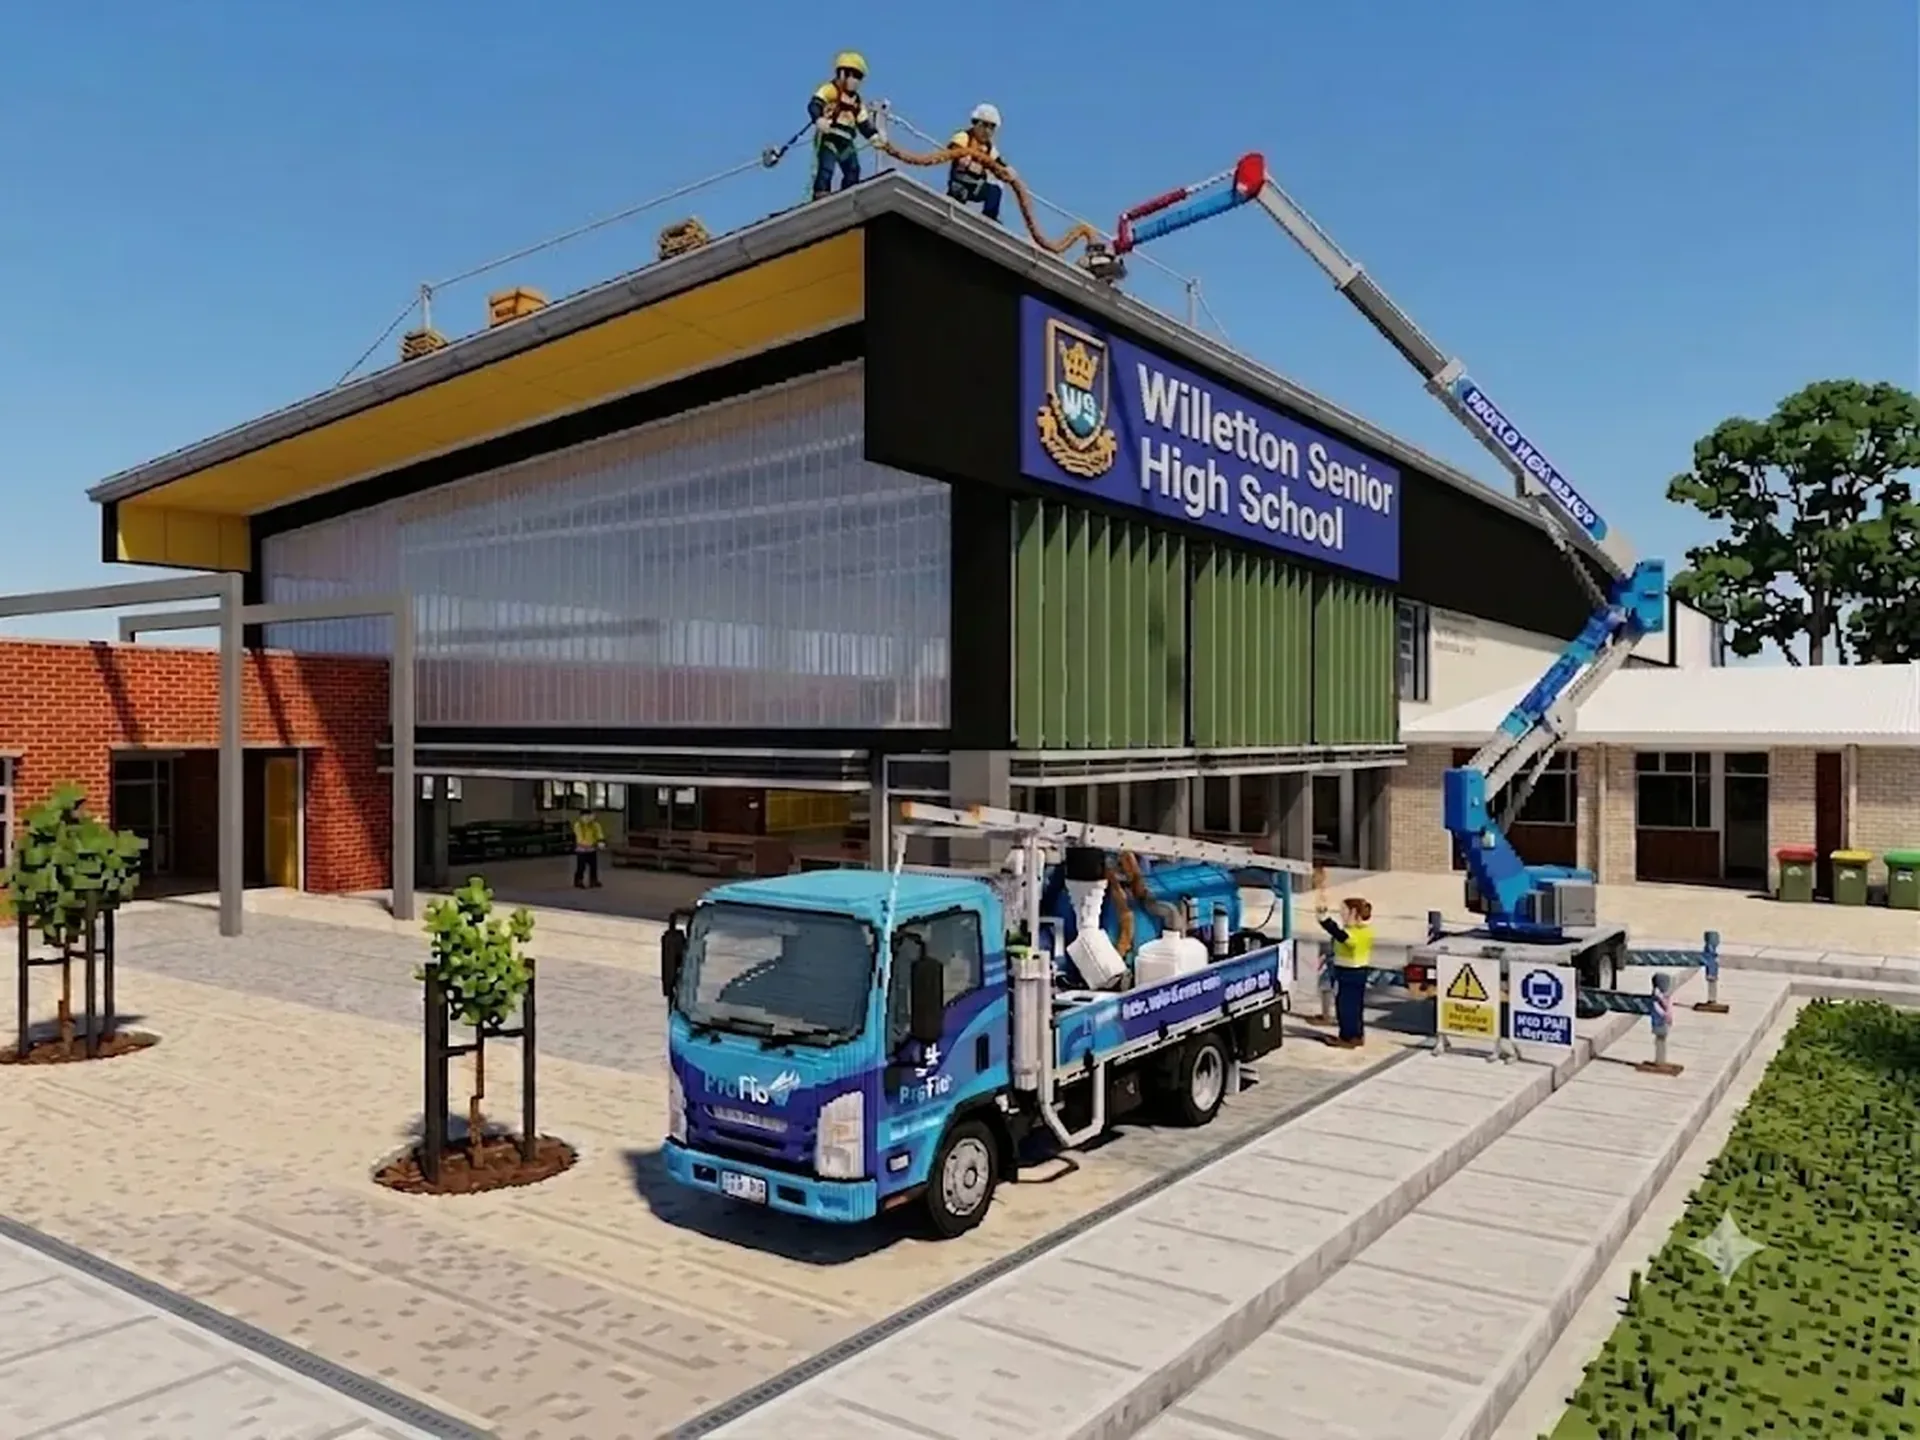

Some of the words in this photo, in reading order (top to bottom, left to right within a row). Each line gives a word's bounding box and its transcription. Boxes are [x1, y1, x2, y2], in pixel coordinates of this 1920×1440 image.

[1136, 362, 1300, 480] Willetton
[1307, 441, 1394, 516] Senior
[1140, 436, 1230, 520] High
[1238, 473, 1345, 551] School
